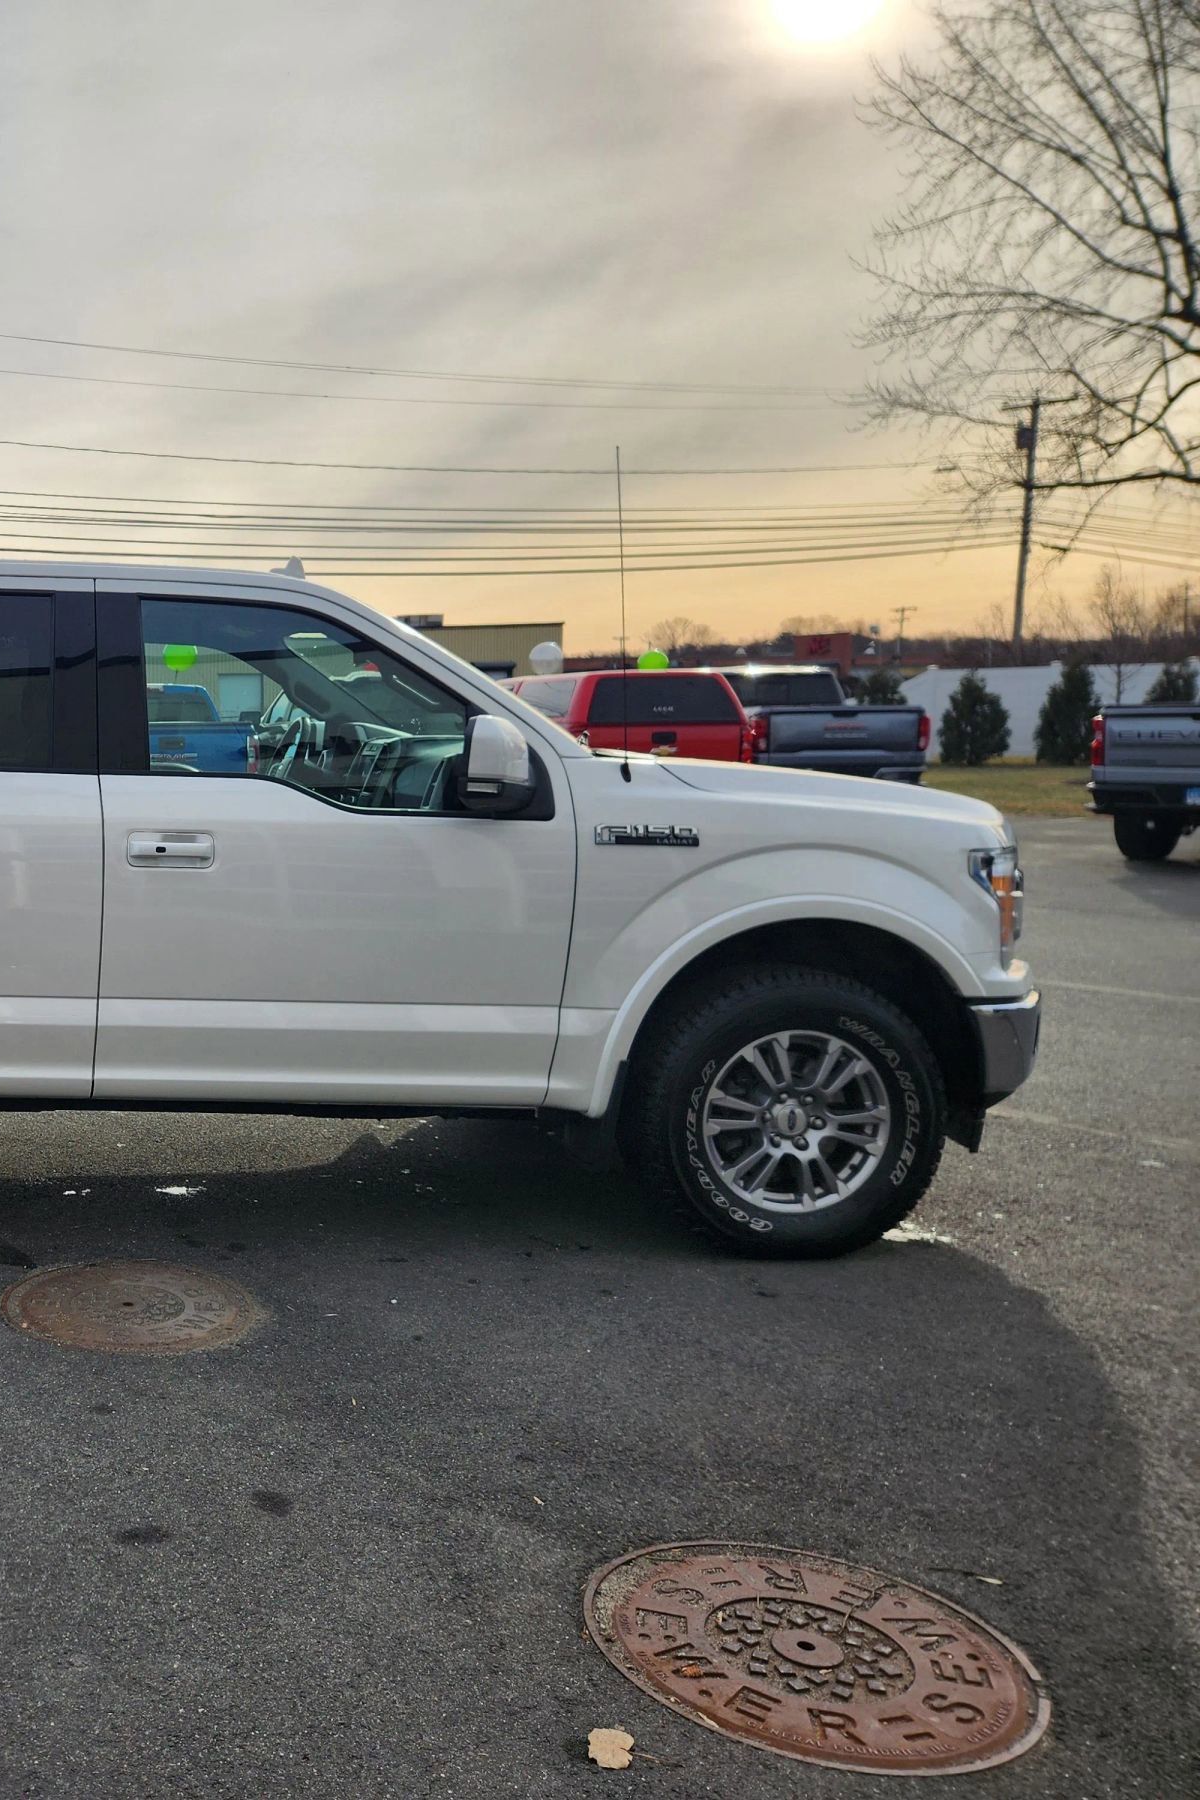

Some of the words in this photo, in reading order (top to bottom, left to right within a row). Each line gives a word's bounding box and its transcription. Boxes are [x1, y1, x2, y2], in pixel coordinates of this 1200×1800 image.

[1117, 729, 1200, 739] CHEV
[687, 1060, 773, 1231] GOODYEAR
[839, 1016, 920, 1186] WRANGLER
